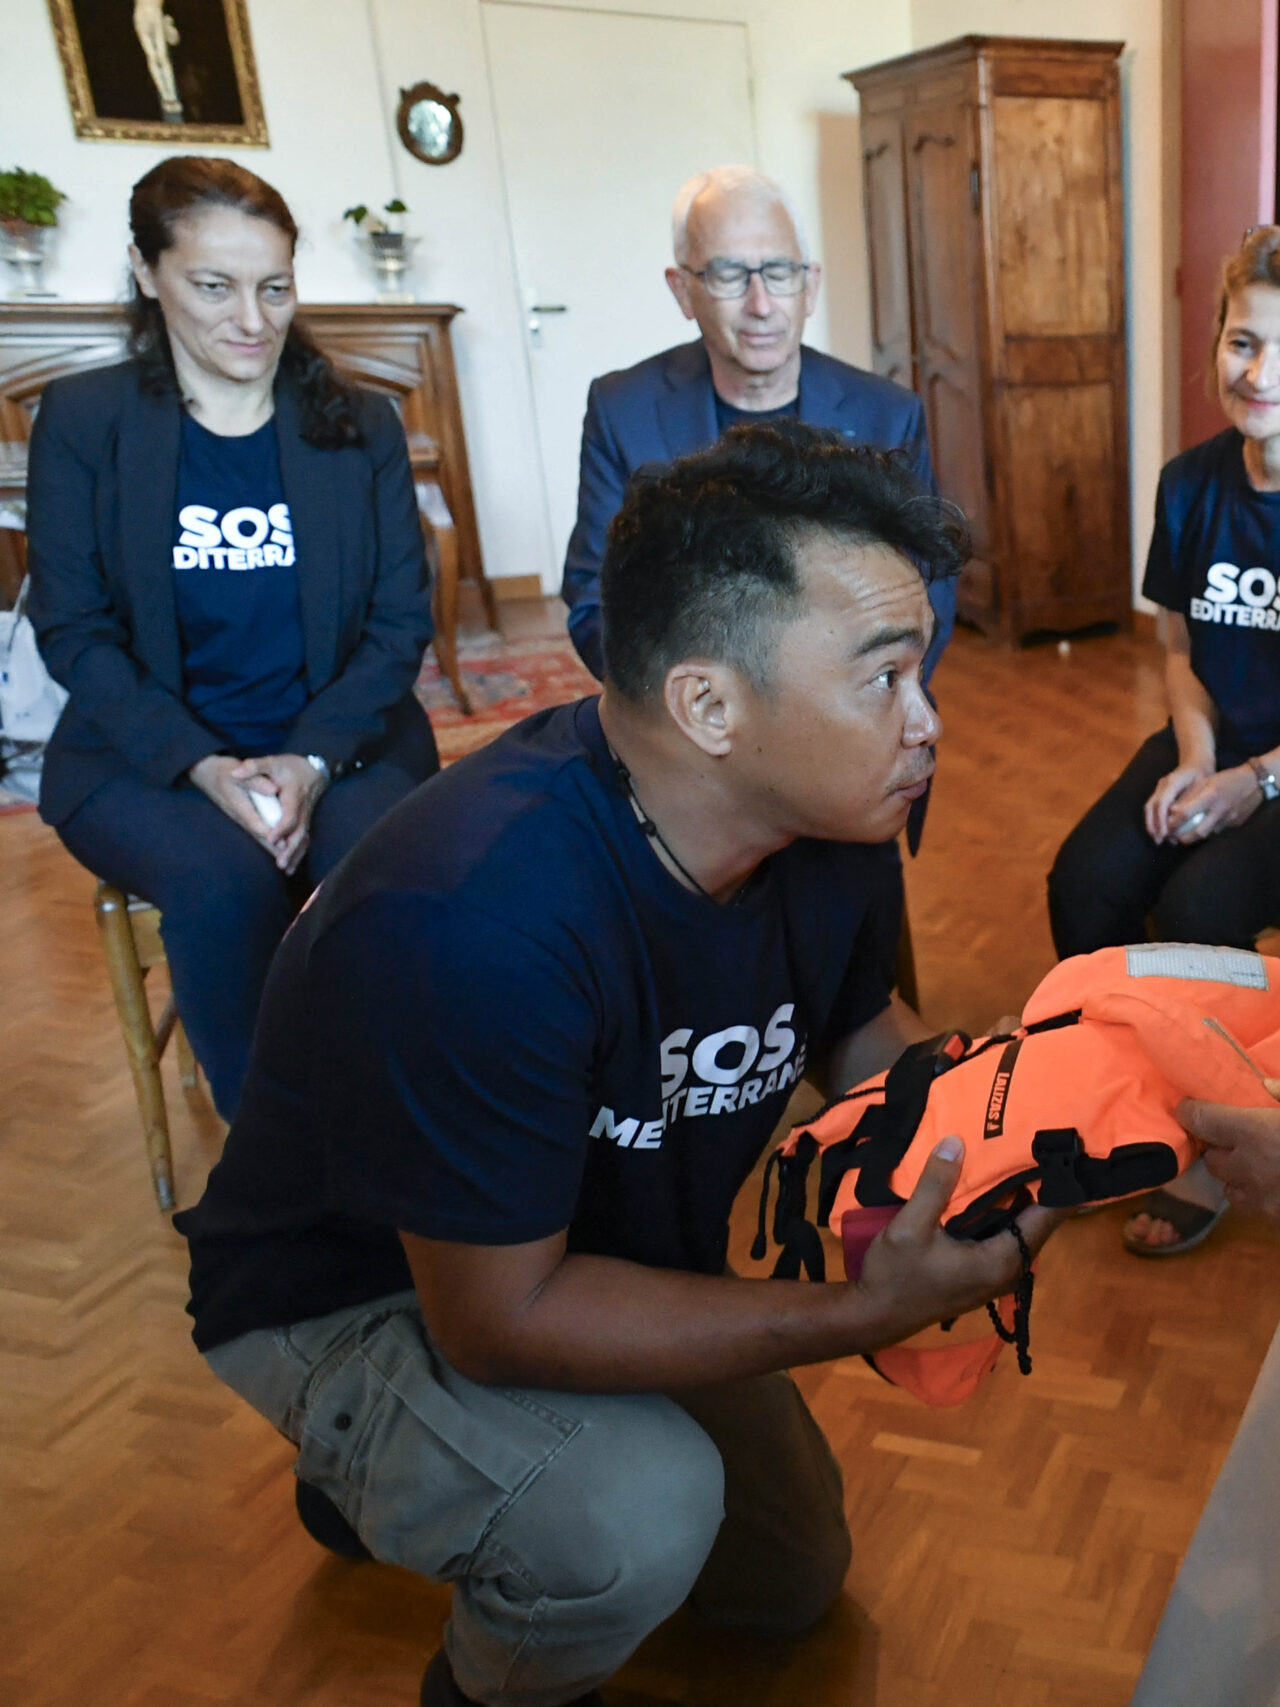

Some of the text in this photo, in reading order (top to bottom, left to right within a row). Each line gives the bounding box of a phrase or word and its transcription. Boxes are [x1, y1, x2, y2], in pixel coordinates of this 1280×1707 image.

[178, 503, 294, 549] SOS
[171, 543, 296, 571] DITERRA
[659, 1003, 796, 1099] SOS
[987, 1072, 1010, 1121] LALIZAS
